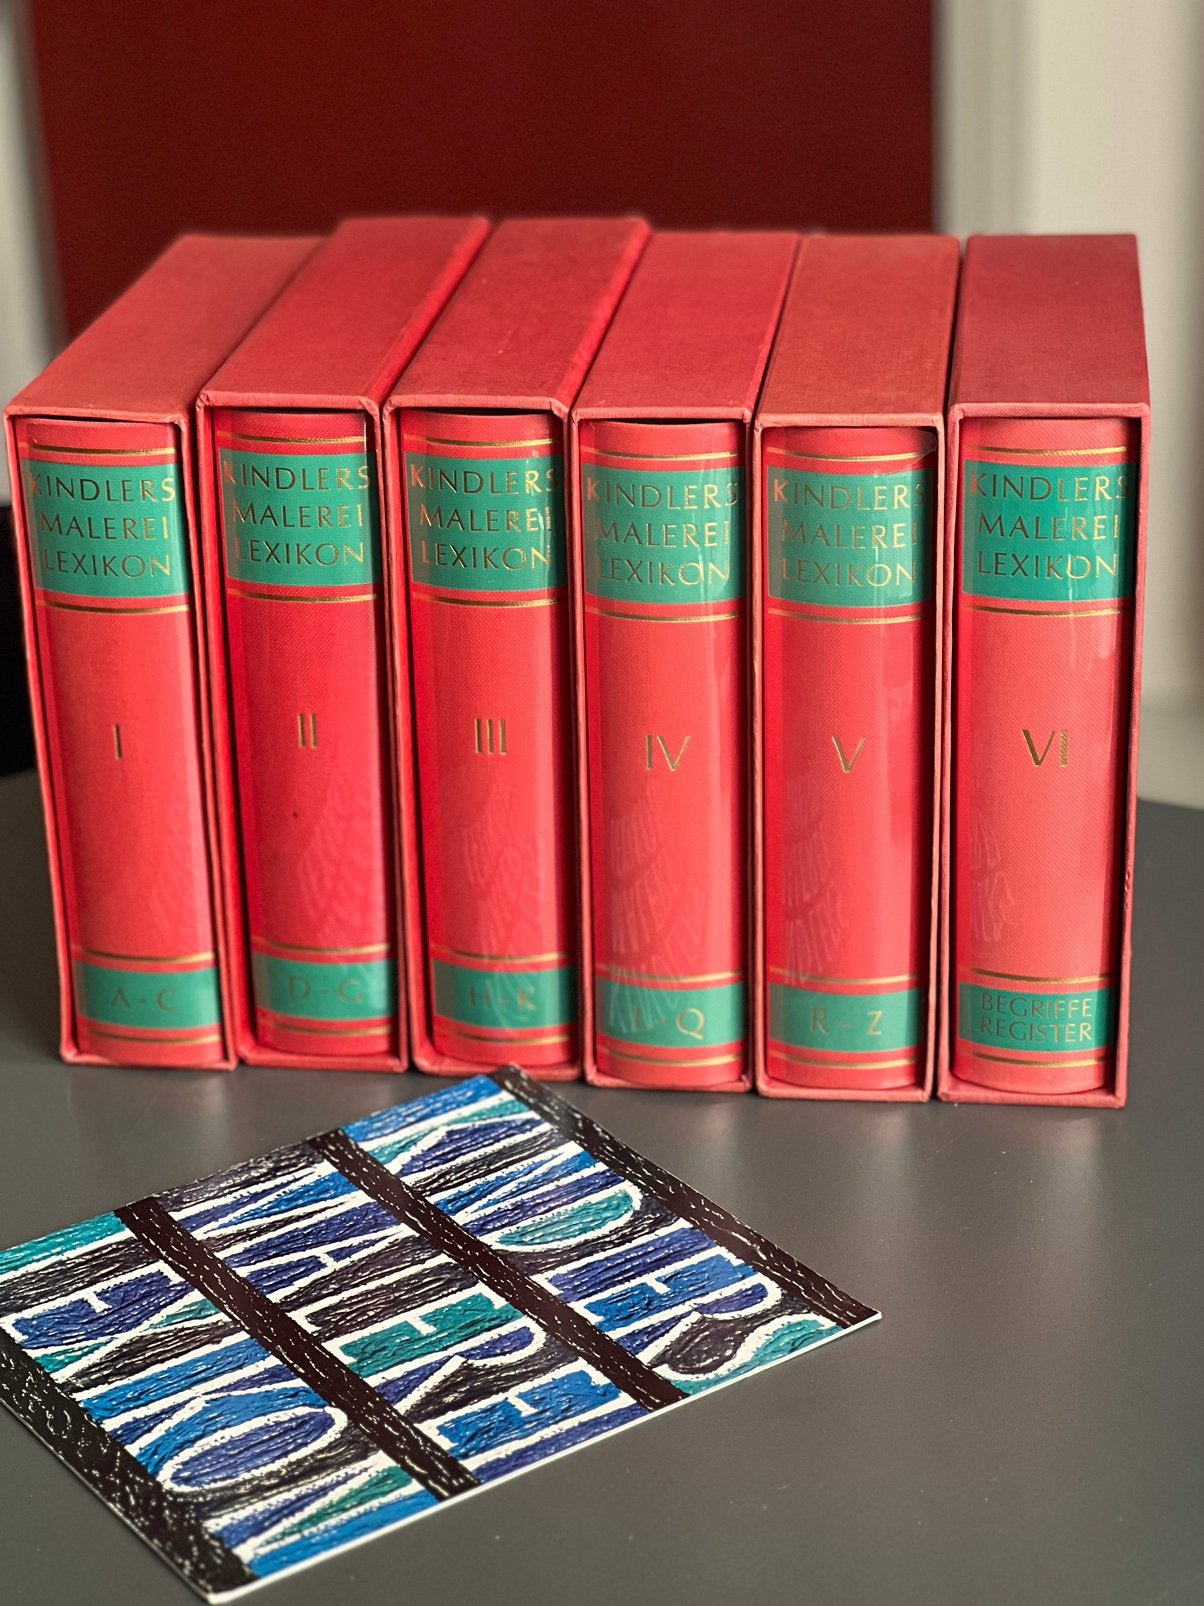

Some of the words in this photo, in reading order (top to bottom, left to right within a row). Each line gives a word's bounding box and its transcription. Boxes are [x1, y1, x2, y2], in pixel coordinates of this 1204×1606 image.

[30, 475, 176, 502] KINDLERS
[223, 459, 371, 491] KINDLERS
[411, 463, 560, 494] KINDLERS
[970, 473, 1130, 502] KINDLERS
[587, 477, 738, 509] KINDLERS
[773, 478, 925, 512] KINDLERS
[41, 511, 169, 541] MALEREI
[234, 504, 363, 529] MALEREI
[420, 504, 552, 533] MALEREI
[978, 512, 1120, 541] MALEREI
[594, 520, 729, 549] MALEREI
[781, 519, 918, 550] MALEREI
[44, 550, 171, 578] LEXIKON
[235, 537, 365, 567] LEXIKON
[421, 540, 552, 571] LEXIKON
[978, 550, 1118, 580] LEXIKON
[596, 558, 730, 586] LEXIKON
[782, 557, 917, 587] LEXIKON
[298, 713, 318, 748] II
[475, 718, 506, 755] III
[645, 734, 691, 772] IV
[832, 735, 866, 773] V
[1022, 729, 1069, 767] VI
[981, 992, 1093, 1019] BEGRIFFE
[980, 1016, 1092, 1043] REGISTER
